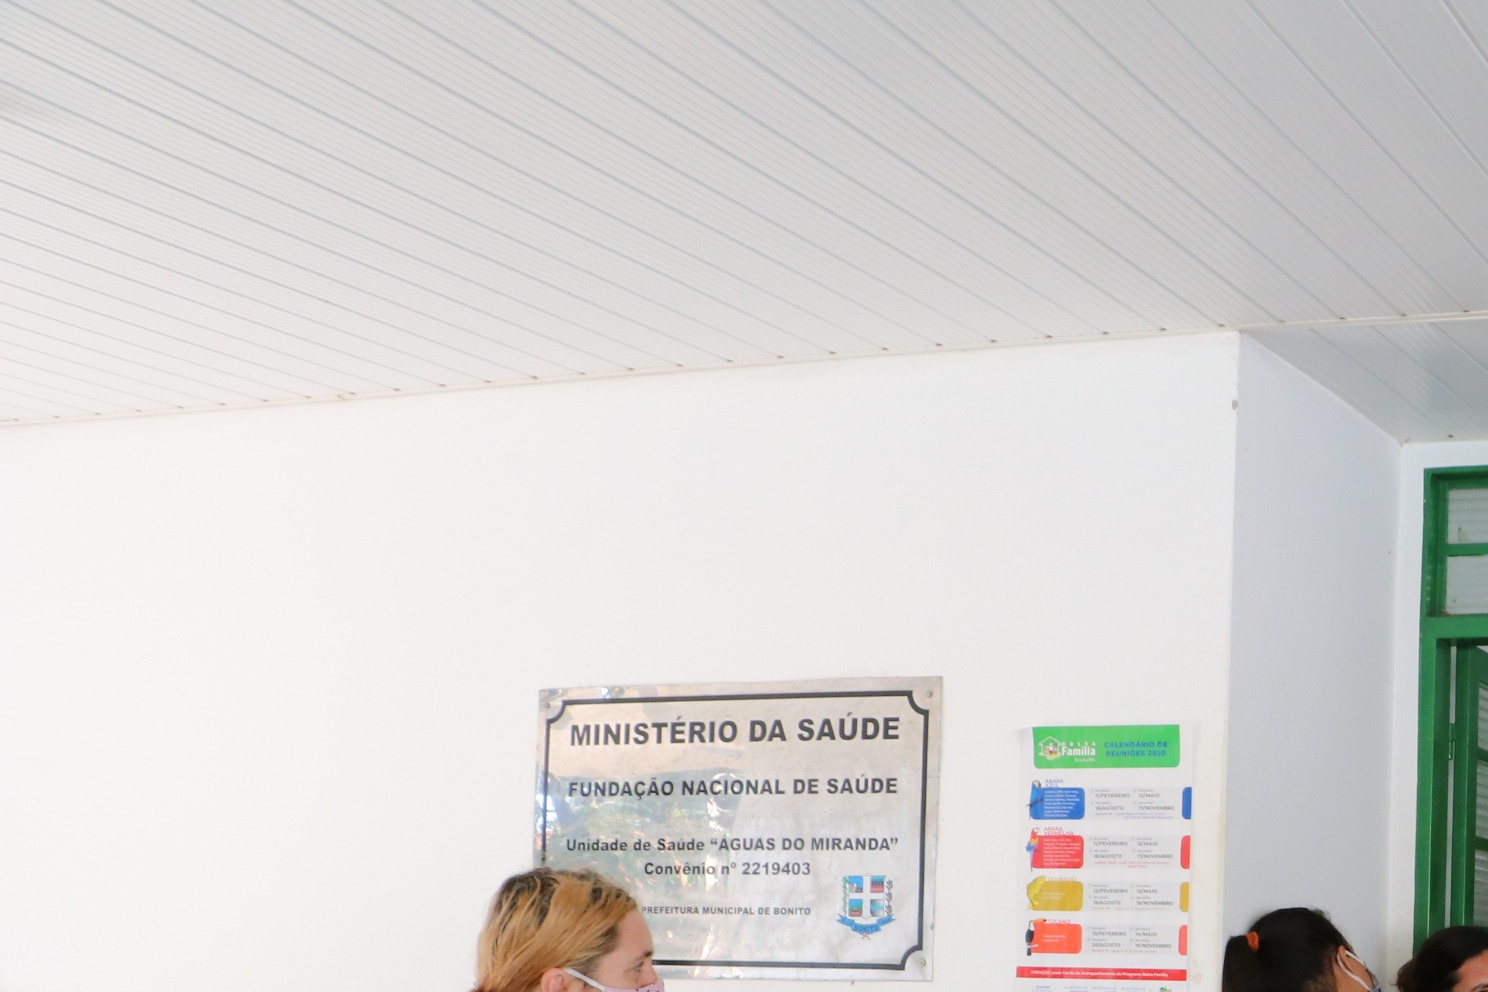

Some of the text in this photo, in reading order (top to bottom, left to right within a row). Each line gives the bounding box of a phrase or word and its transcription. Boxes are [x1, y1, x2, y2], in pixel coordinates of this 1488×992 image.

[570, 712, 900, 746] MINISTÉRIO DA SAÚDE
[1061, 745, 1096, 756] Família
[568, 774, 898, 801] FUNDAÇÃO NACIONAL DE SAÚDE
[566, 838, 628, 852] Unidade
[633, 838, 651, 852] de
[657, 838, 704, 852] Saúde
[782, 837, 805, 851] DO
[811, 837, 899, 851] MIRANDA”
[644, 861, 715, 876] Convênio
[742, 862, 811, 876] 2219403
[641, 906, 811, 916] PREFEITURA MUNICIPAL DE BONITO
[854, 923, 880, 933] BONITO
